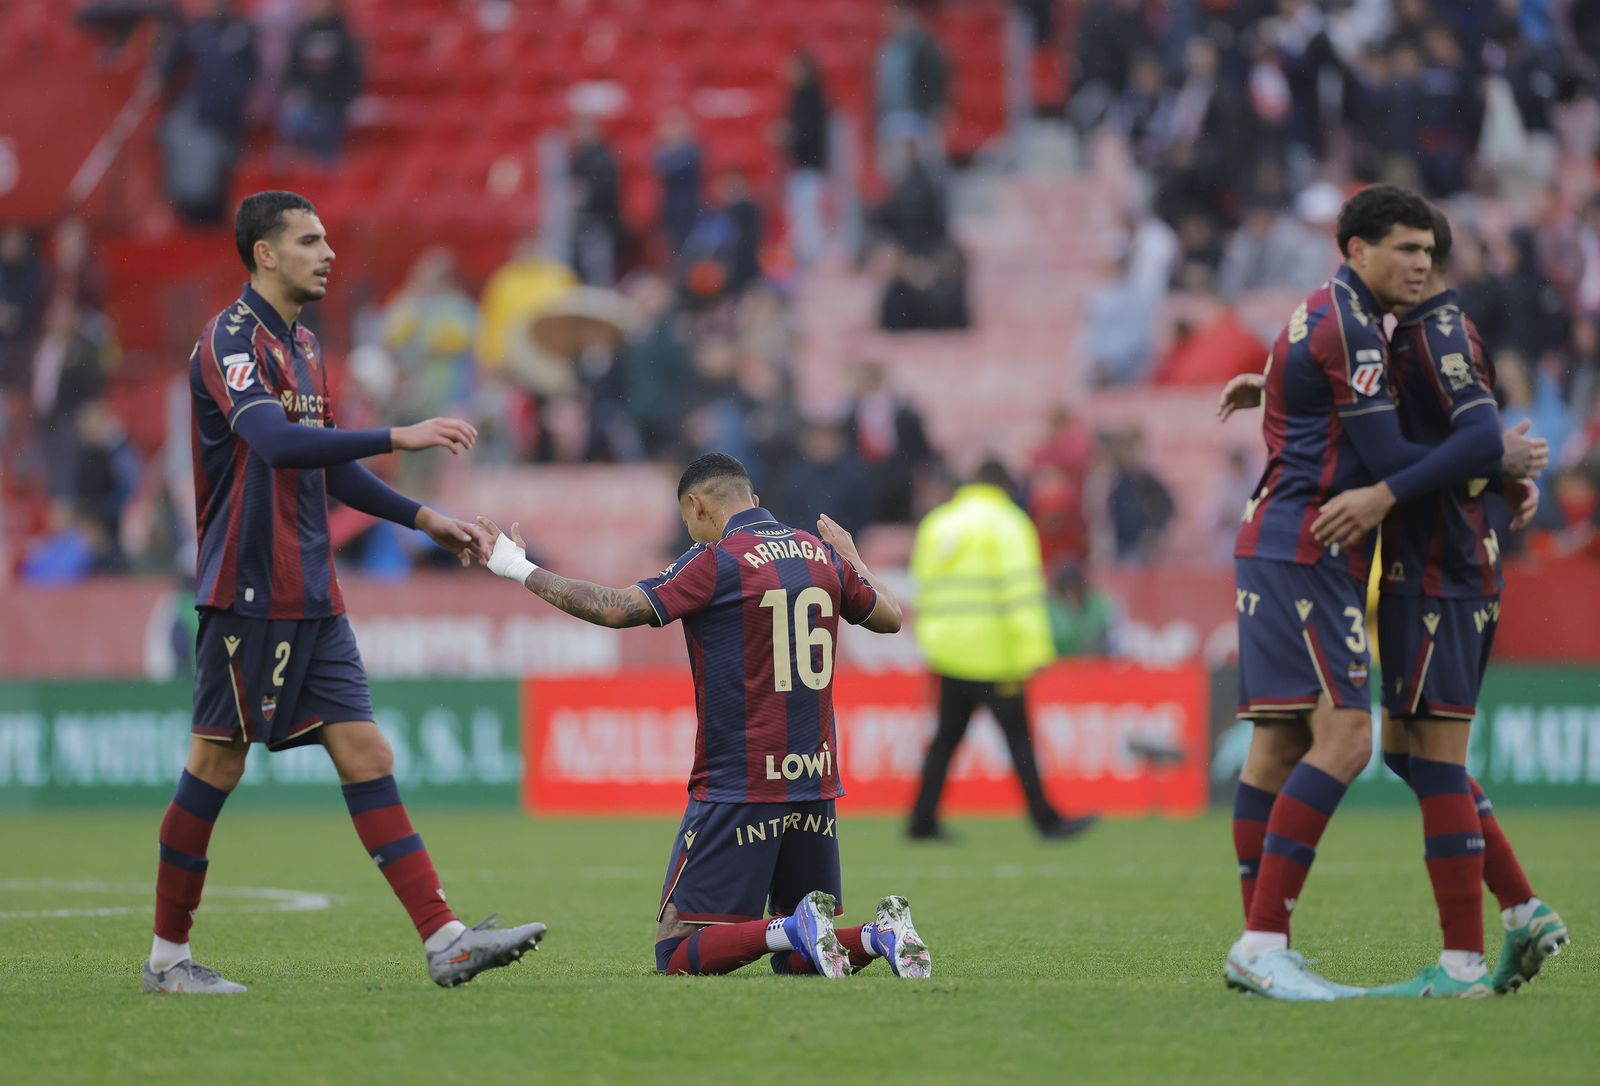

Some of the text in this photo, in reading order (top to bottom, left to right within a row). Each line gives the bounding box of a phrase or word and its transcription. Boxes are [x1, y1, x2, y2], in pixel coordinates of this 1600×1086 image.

[743, 540, 828, 569] ARRIAGA
[759, 586, 833, 692] 16
[1343, 606, 1367, 653] 3
[272, 641, 291, 686] 2
[736, 812, 838, 846] INTERNX
